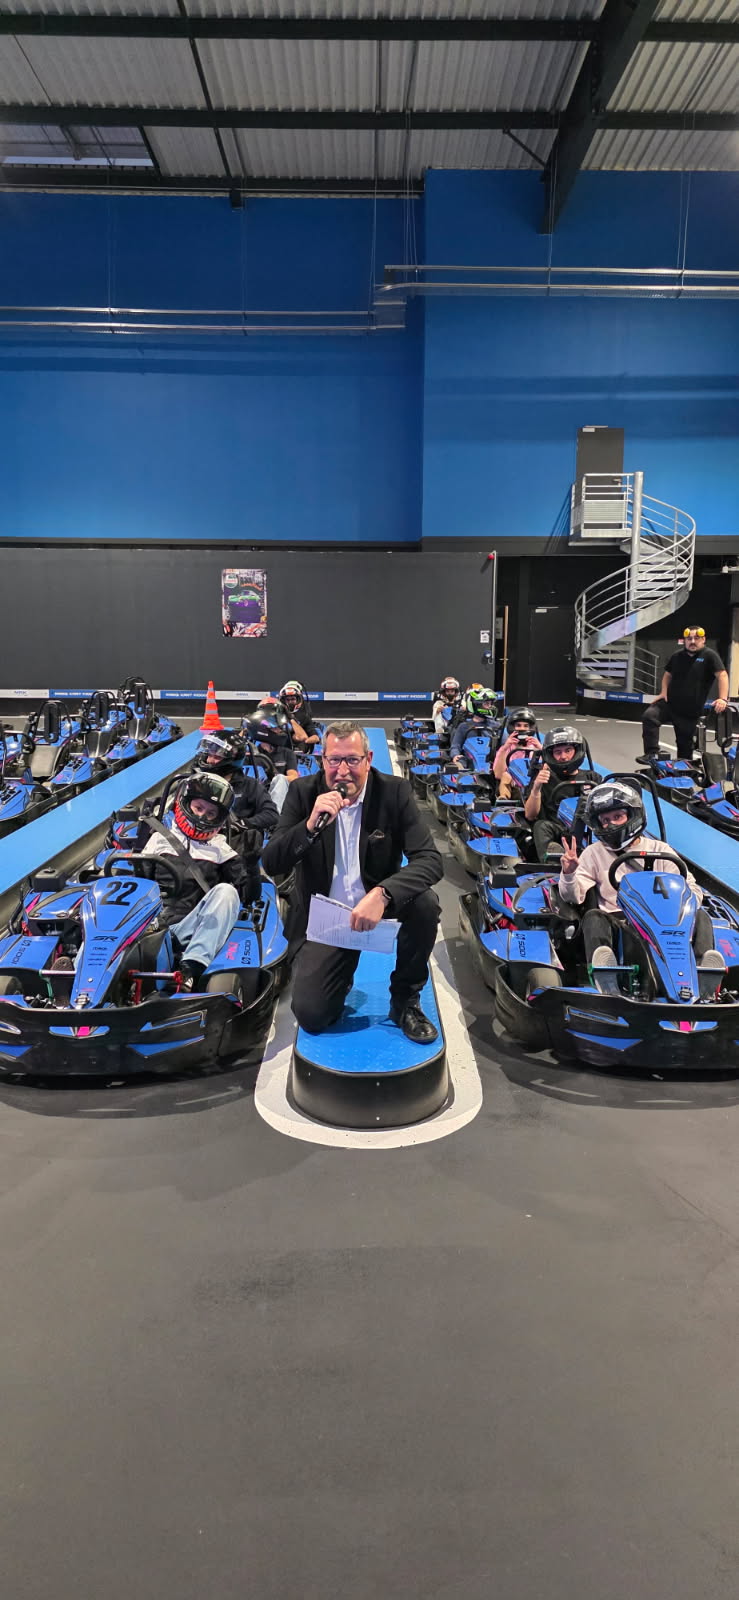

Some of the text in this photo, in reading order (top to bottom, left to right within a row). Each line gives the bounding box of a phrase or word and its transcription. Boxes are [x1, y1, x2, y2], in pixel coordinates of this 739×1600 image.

[99, 881, 139, 906] 22
[652, 876, 669, 900] 4
[243, 939, 252, 956] SODI
[517, 940, 526, 957] SODI
